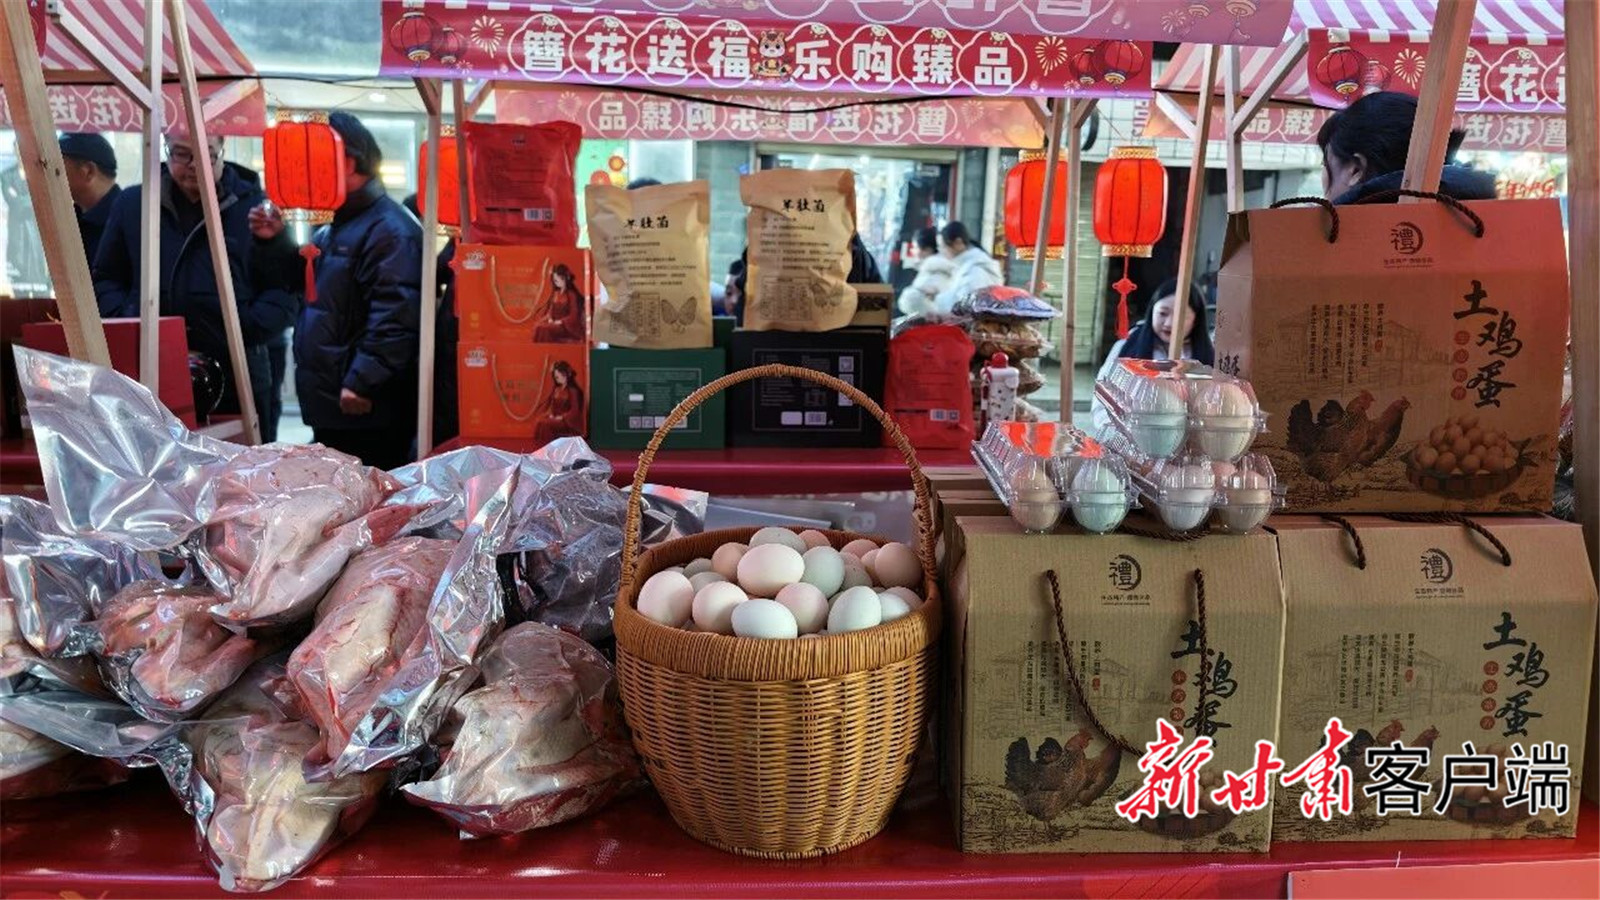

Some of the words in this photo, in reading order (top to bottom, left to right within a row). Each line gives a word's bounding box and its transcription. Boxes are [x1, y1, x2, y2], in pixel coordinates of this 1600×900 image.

[523, 30, 750, 77] 簪花送福
[793, 40, 1012, 85] 乐购臻品
[1453, 280, 1523, 408] 土鸡蛋
[1483, 611, 1550, 737] 土鸡蛋
